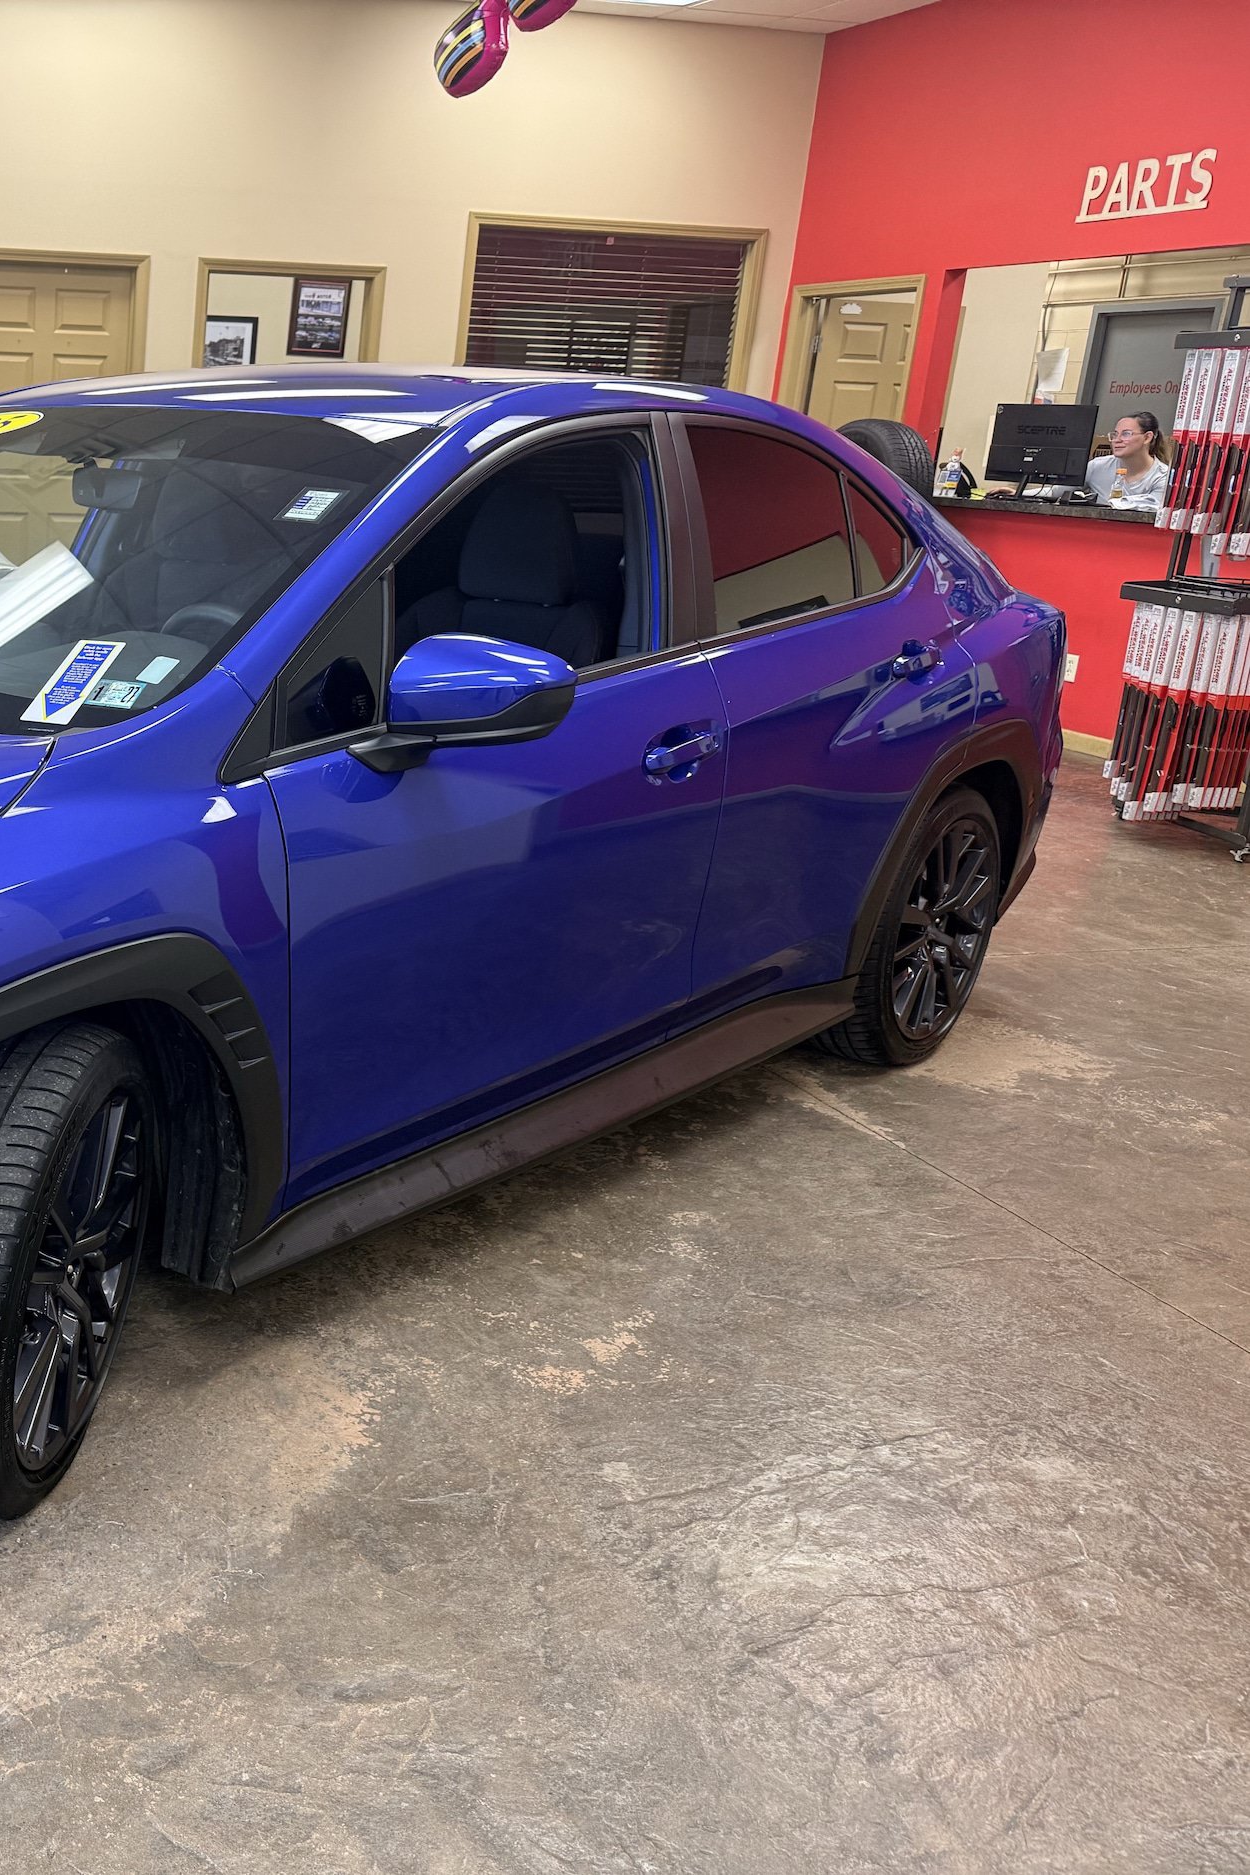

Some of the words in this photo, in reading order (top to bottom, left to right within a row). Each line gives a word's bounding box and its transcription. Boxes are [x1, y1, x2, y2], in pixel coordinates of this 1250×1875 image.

[1077, 148, 1217, 222] PARTS
[1110, 380, 1162, 398] Employees
[1179, 367, 1192, 420] ALL-WEATHER
[1194, 367, 1209, 421] ALL-WEATHER
[1219, 368, 1234, 422] ALL-WEATHER
[1017, 424, 1067, 436] SCEPTRE
[1159, 624, 1173, 675] ALL-WEATHER
[1176, 628, 1190, 680] ALL-WEATHER
[1215, 631, 1228, 684] ALL-WEATHER
[92, 685, 105, 701] 1
[120, 686, 141, 703] 27
